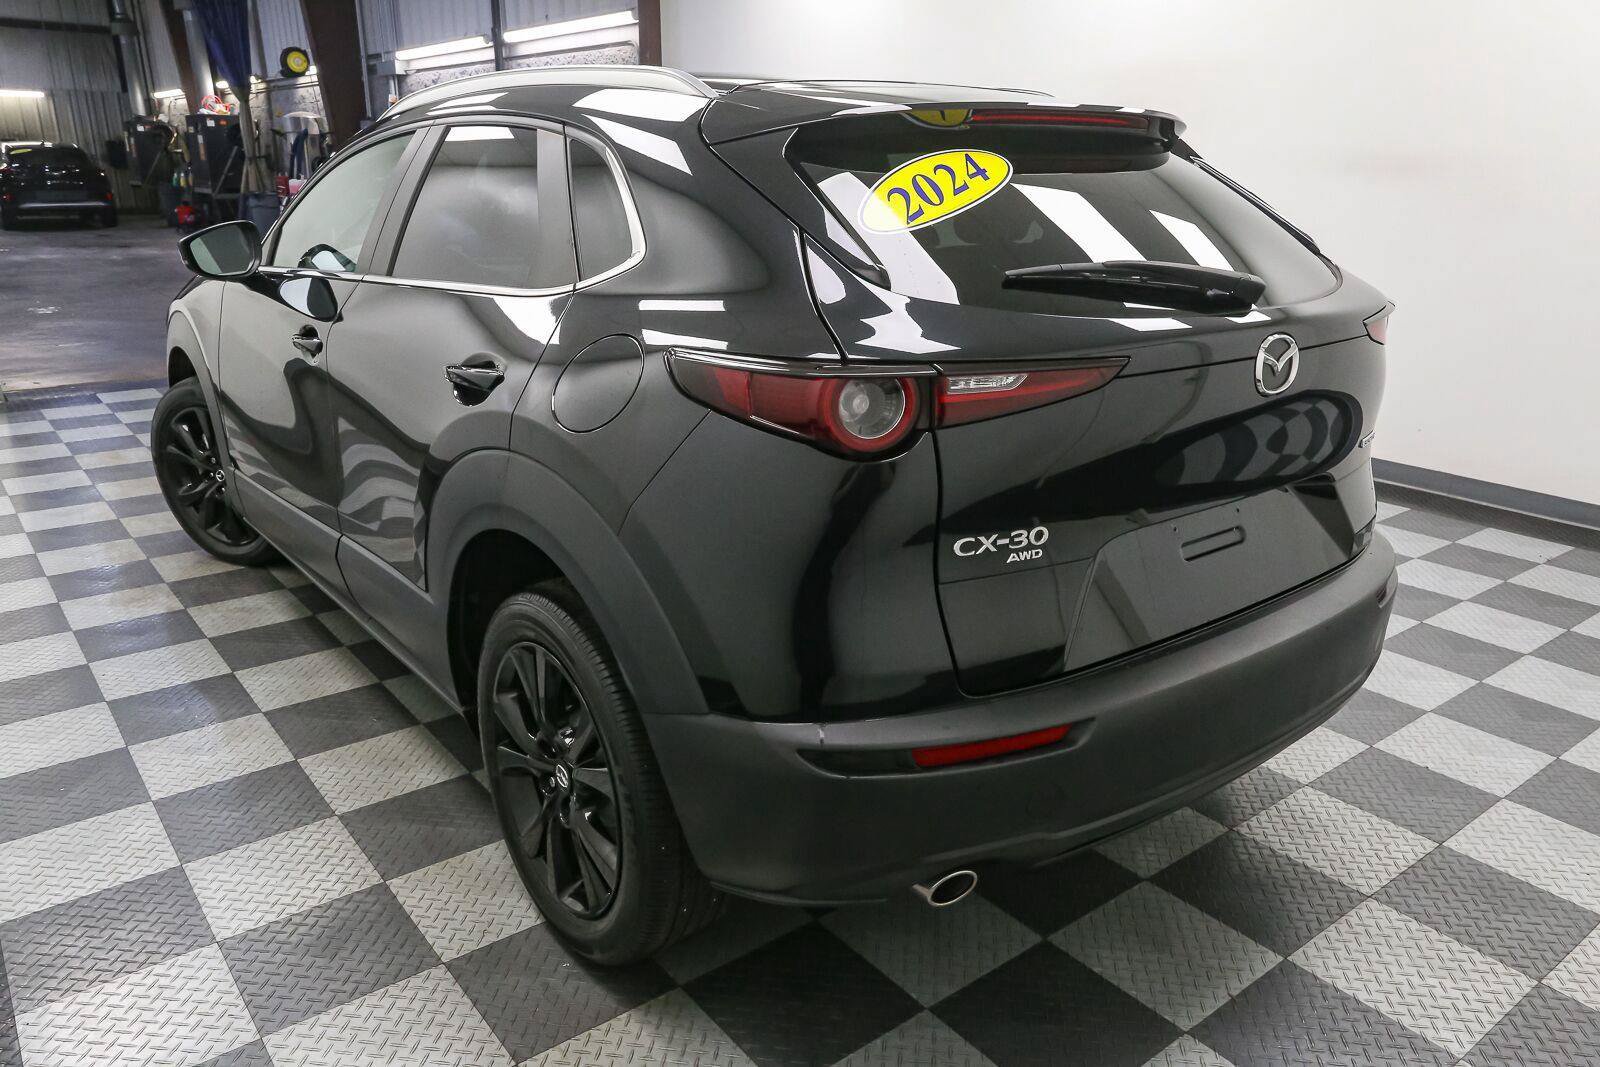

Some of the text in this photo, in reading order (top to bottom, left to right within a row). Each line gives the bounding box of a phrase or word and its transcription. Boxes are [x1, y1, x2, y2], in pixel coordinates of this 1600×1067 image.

[887, 153, 990, 225] 2024
[953, 526, 1049, 557] CX-30
[1006, 548, 1043, 564] AWD
